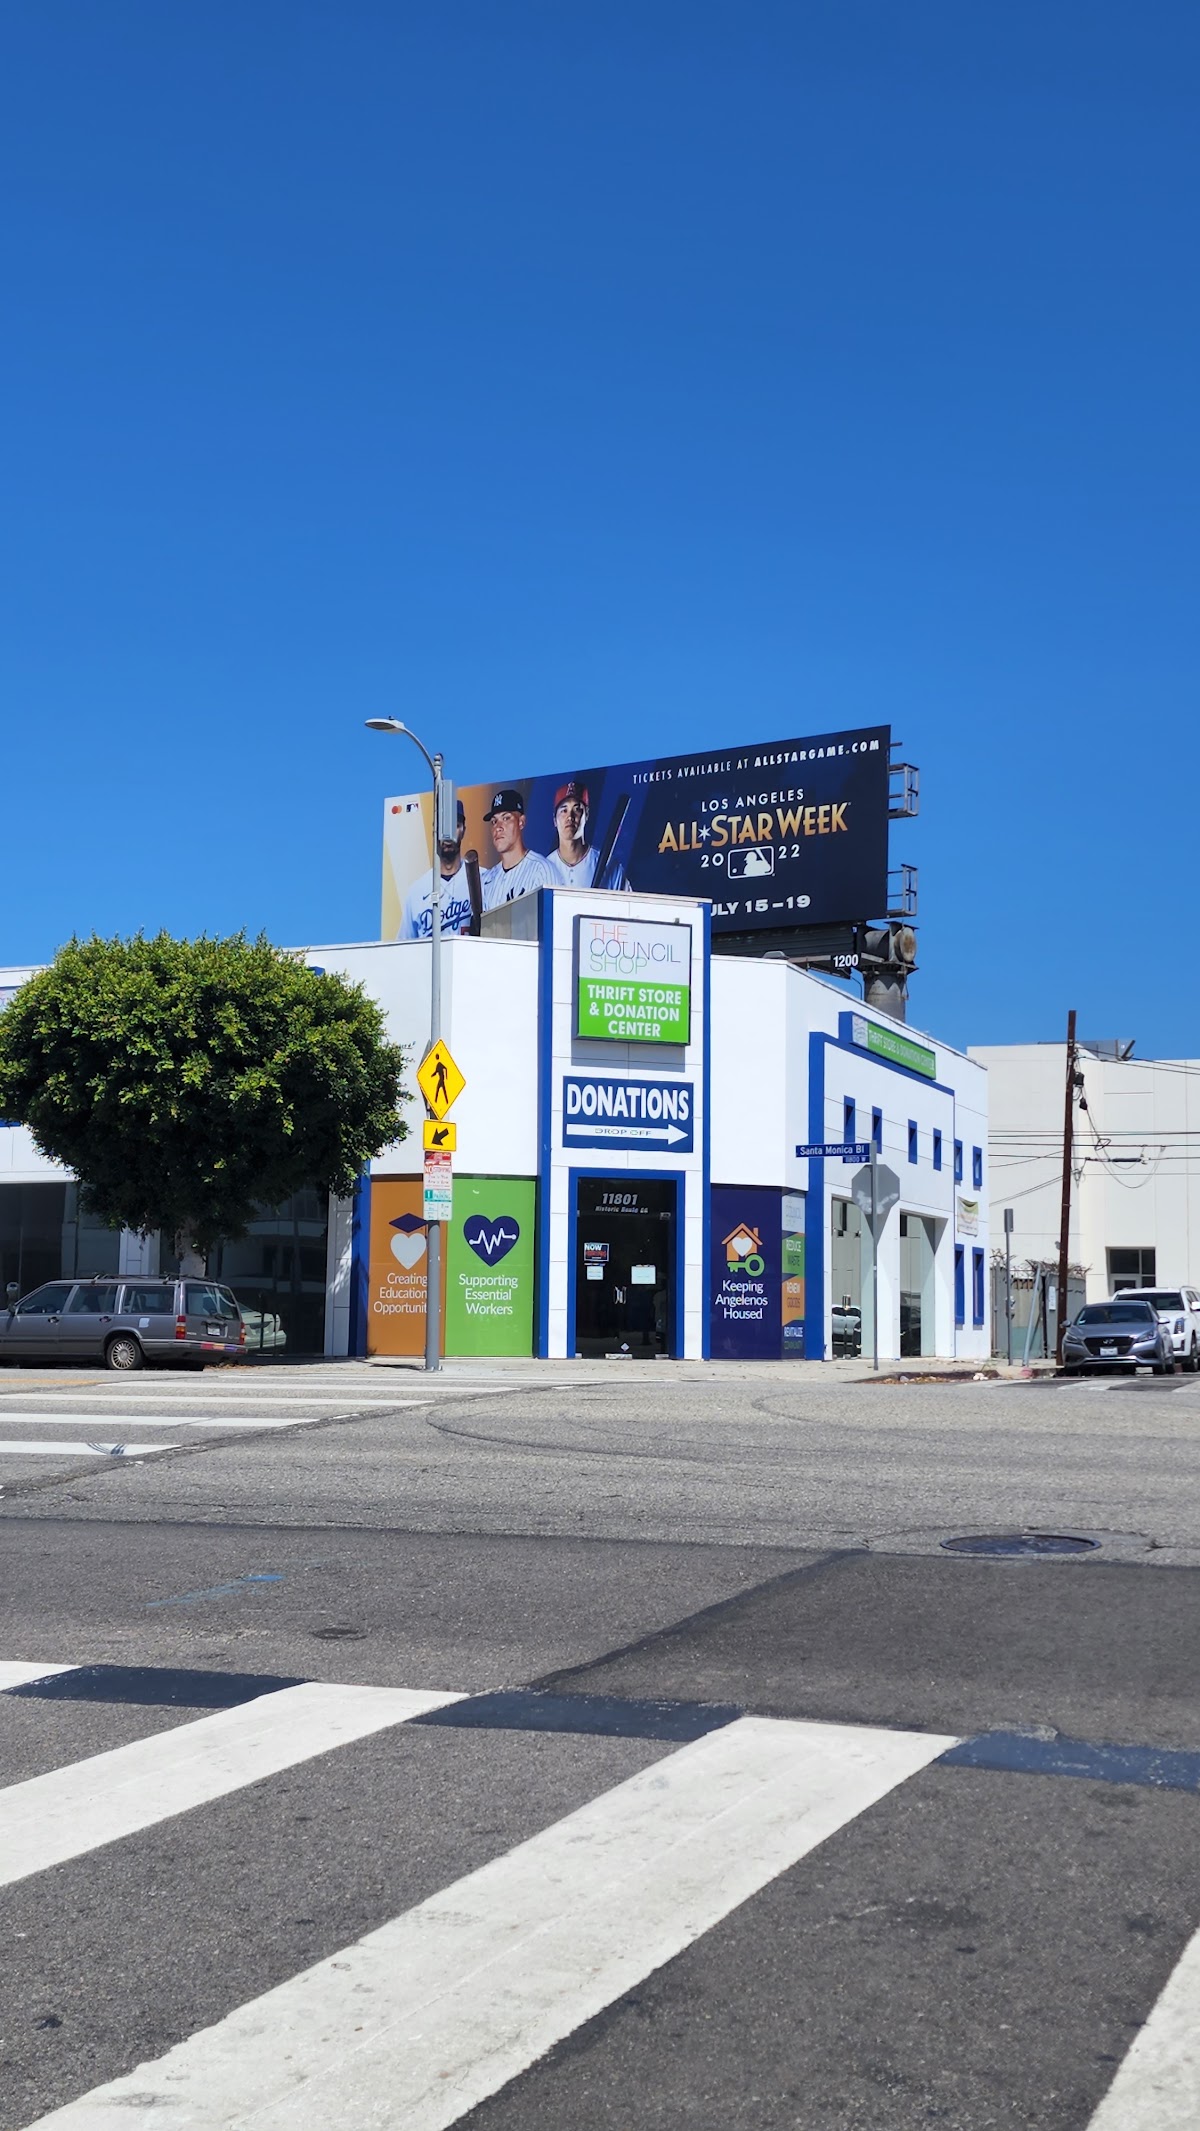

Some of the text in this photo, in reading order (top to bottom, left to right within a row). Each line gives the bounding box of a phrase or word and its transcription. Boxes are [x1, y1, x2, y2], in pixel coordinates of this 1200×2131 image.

[633, 739, 880, 784] TICKETS AVAILABLE AT ALLSTARGAME.COM
[701, 788, 805, 813] LOS ANGELES
[775, 802, 849, 837] WEEK
[420, 899, 471, 935] Dodge
[589, 923, 629, 943] THE
[589, 937, 681, 963] COUNCIL
[589, 953, 648, 975] SHOP
[833, 954, 859, 968] 1200
[587, 984, 682, 1005] THRIFT STORE
[589, 1002, 680, 1022] & DONATION
[608, 1020, 661, 1037] CENTER
[567, 1083, 689, 1121] DONATIONS
[800, 1146, 823, 1155] Santa
[825, 1145, 853, 1154] Monica
[602, 1193, 638, 1205] 11801
[595, 1205, 620, 1213] Historic
[387, 1272, 428, 1287] Creating
[458, 1273, 519, 1289] Supporting
[722, 1280, 764, 1294] Keeping
[379, 1287, 428, 1299] Education
[465, 1288, 512, 1301] Essential
[715, 1293, 768, 1308] Angelenos
[373, 1301, 441, 1315] Opportunit
[466, 1302, 513, 1315] Workers
[723, 1308, 763, 1320] Housed
